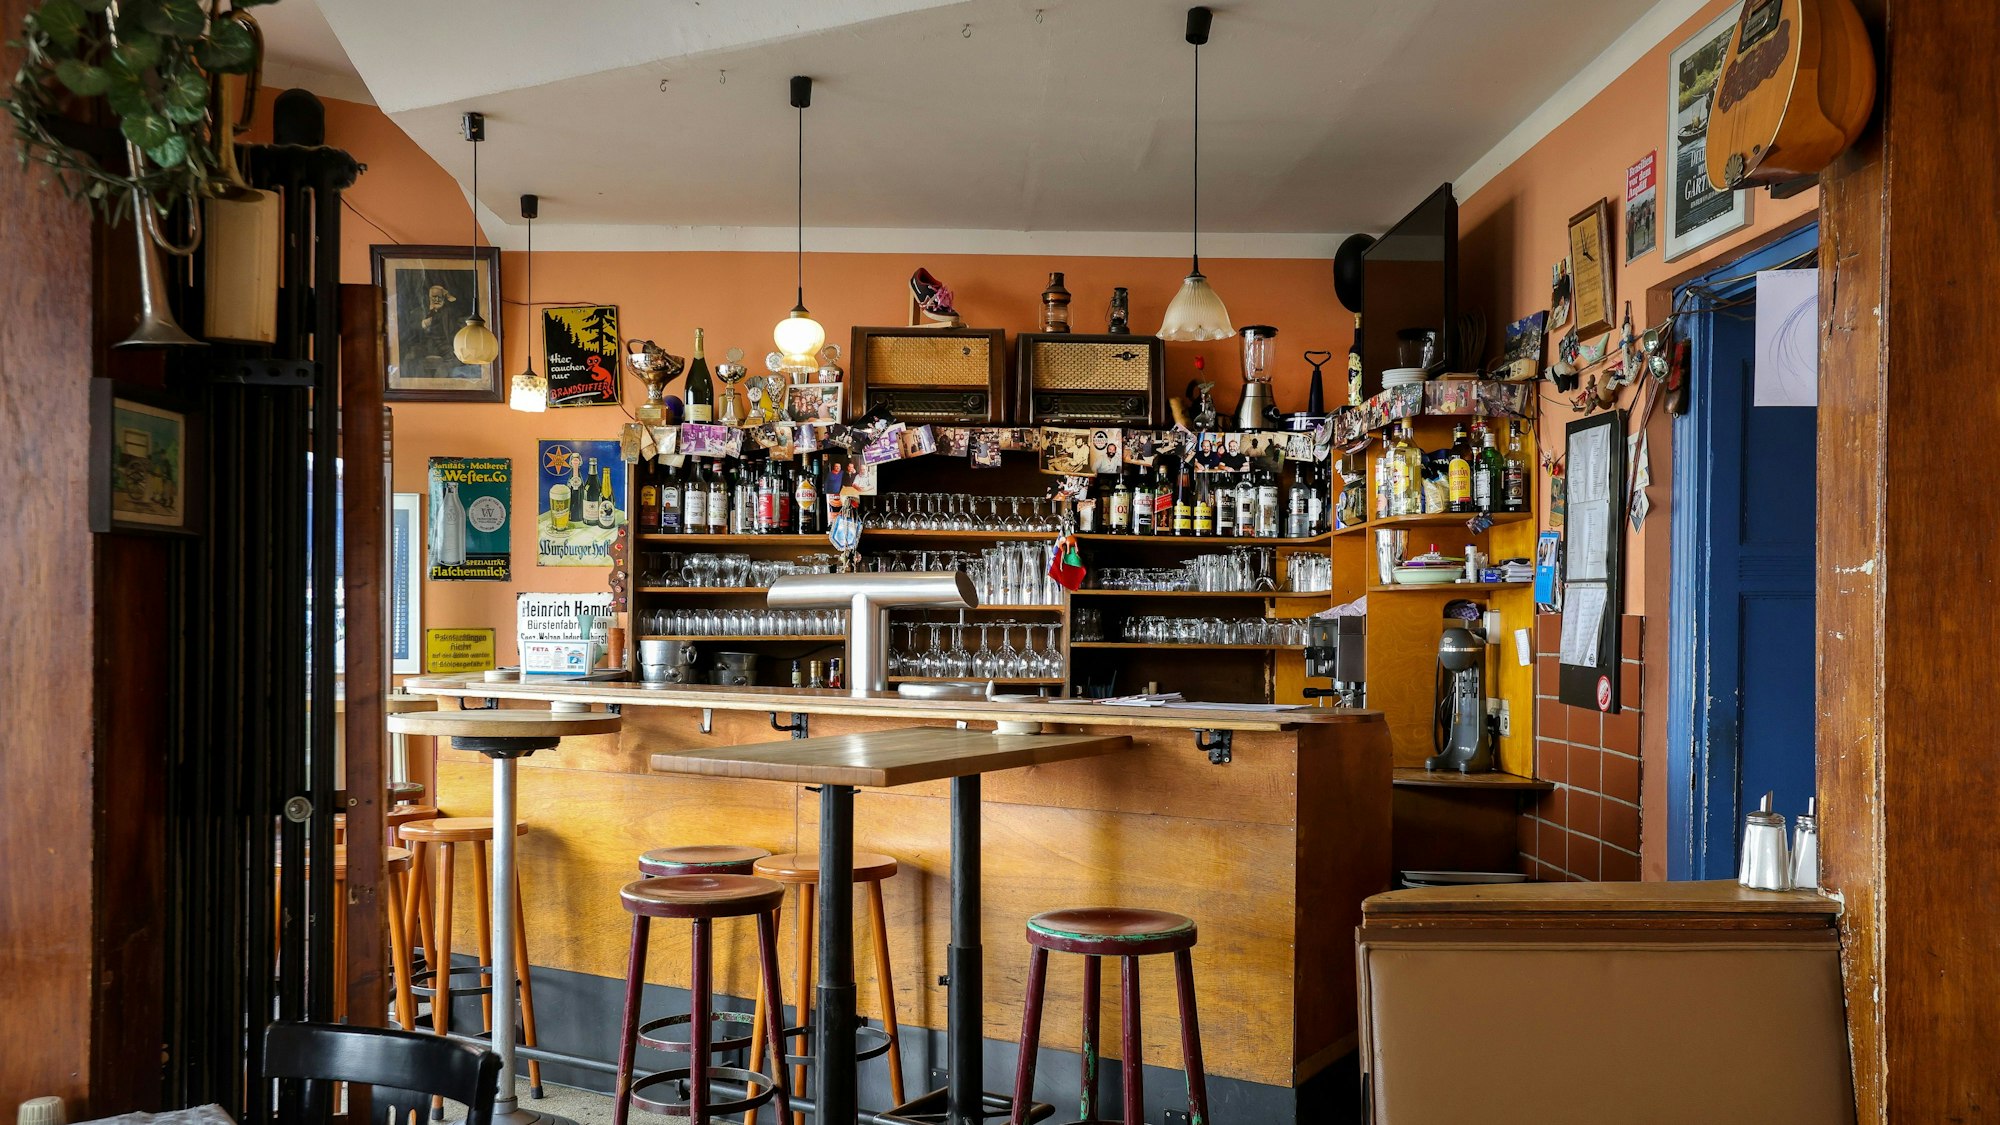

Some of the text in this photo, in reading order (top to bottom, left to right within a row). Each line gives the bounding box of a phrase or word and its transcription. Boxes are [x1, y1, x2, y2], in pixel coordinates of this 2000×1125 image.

[1629, 155, 1653, 177] Brasilien
[1629, 167, 1651, 187] vor dem
[1628, 178, 1647, 198] Anpfiff
[550, 353, 572, 364] Hier
[551, 362, 585, 373] rauchen
[470, 462, 508, 470] Molkerei
[540, 539, 591, 559] Würzburger
[522, 600, 570, 617] Heinrich
[450, 643, 472, 651] nicht
